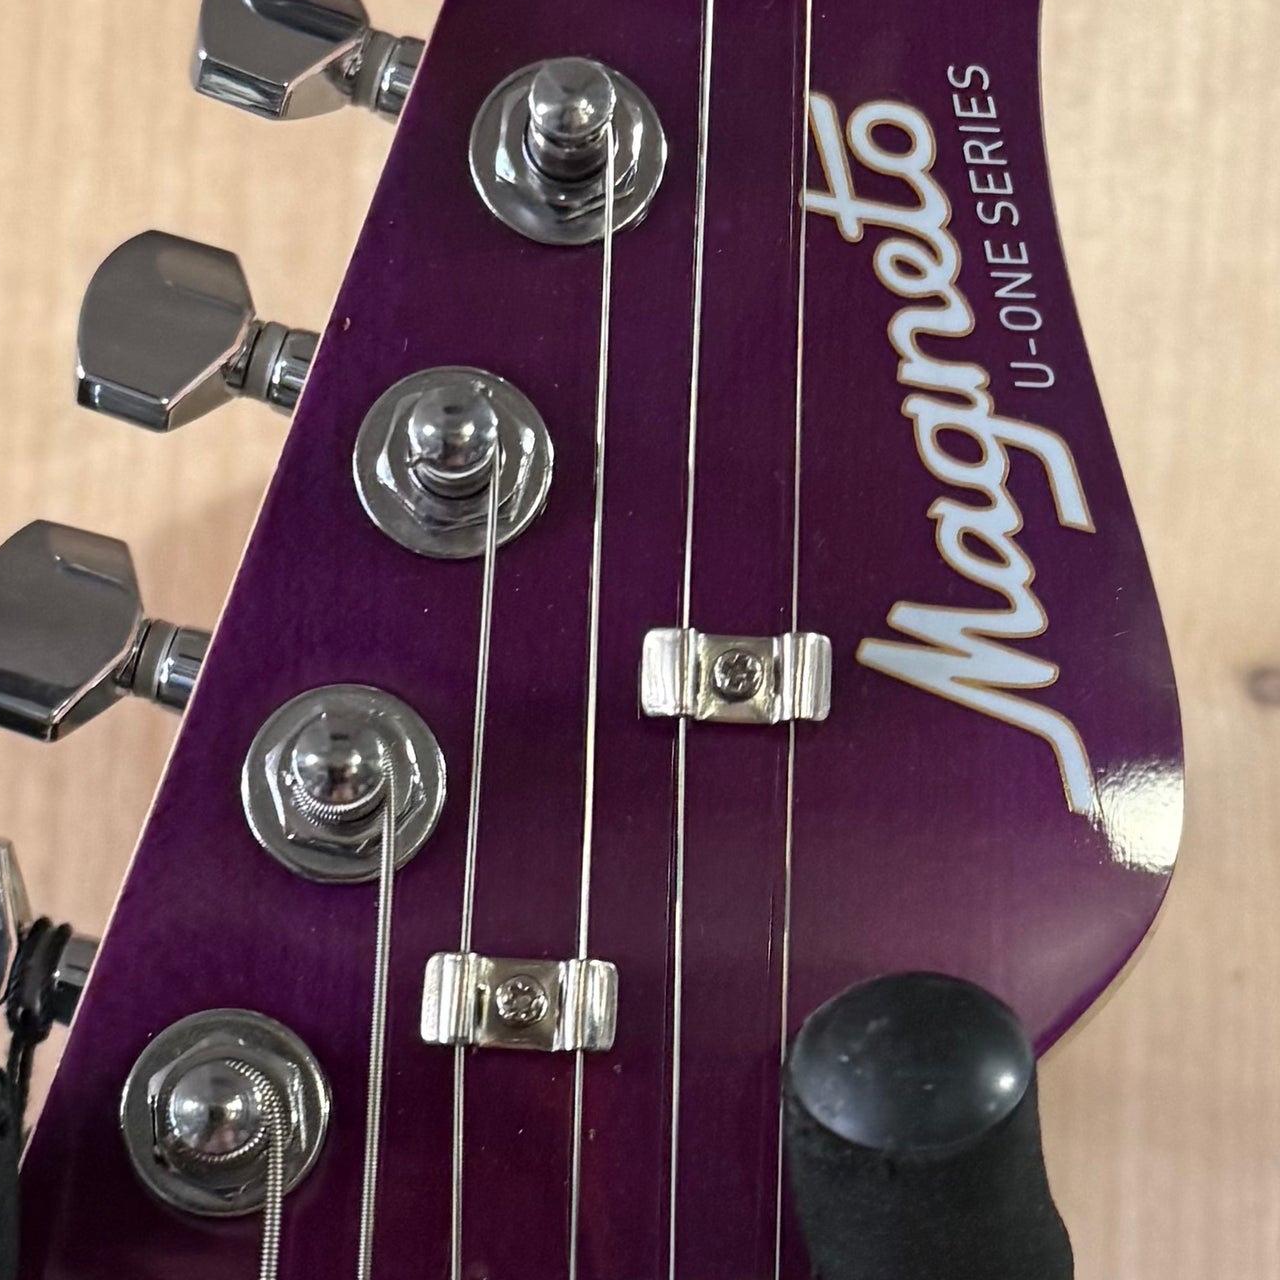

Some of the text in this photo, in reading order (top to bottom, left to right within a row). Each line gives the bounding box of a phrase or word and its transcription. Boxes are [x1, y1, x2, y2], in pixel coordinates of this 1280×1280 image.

[799, 90, 1096, 814] Magneto
[947, 63, 1055, 389] U-ONE SERIES
